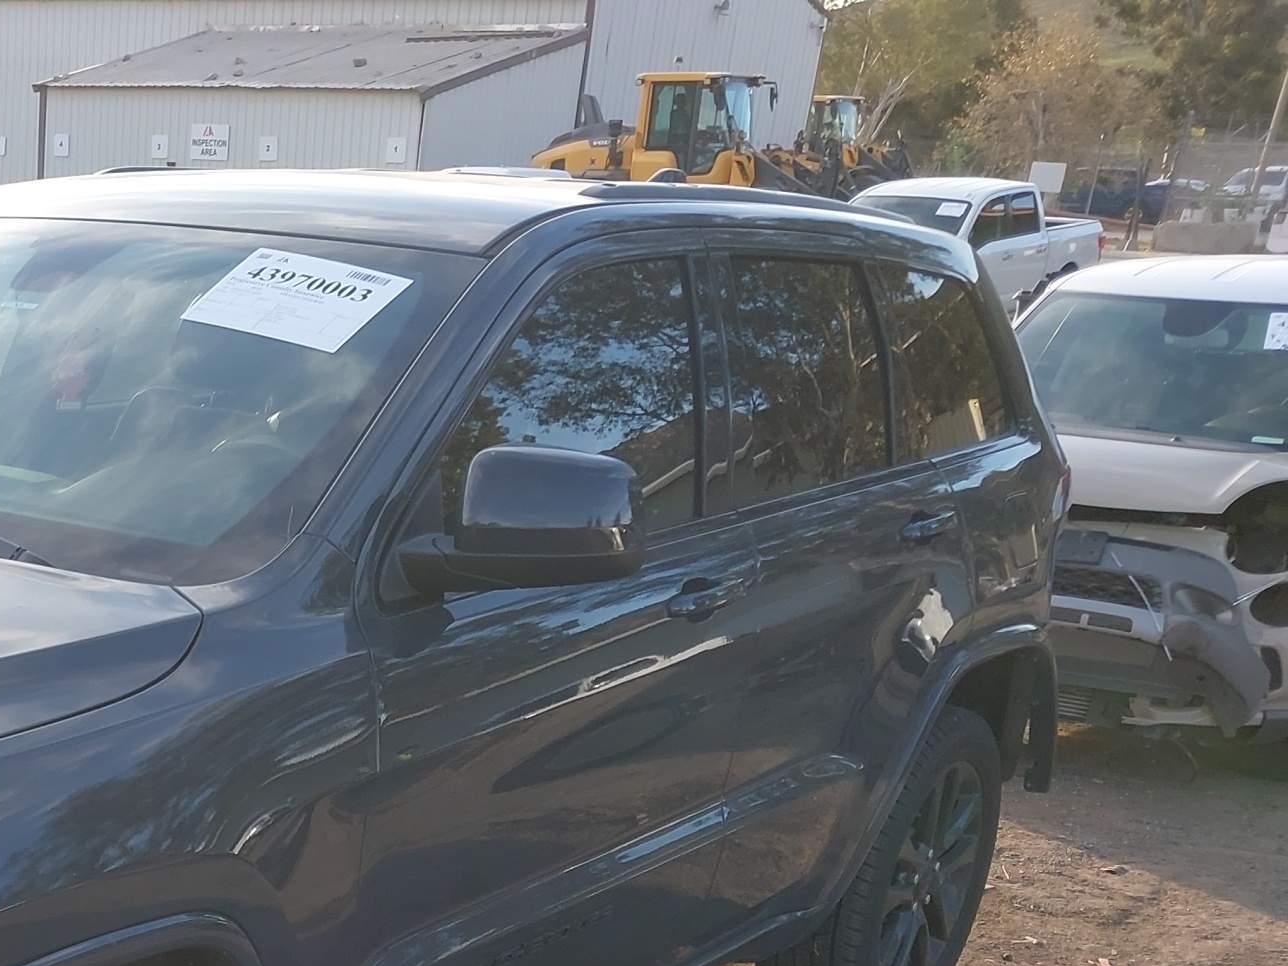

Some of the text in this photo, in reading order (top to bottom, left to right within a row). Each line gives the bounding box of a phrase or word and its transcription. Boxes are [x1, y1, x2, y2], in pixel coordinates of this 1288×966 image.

[191, 138, 227, 148] INSPECTION
[199, 148, 217, 157] AREA
[247, 266, 374, 303] 43970003
